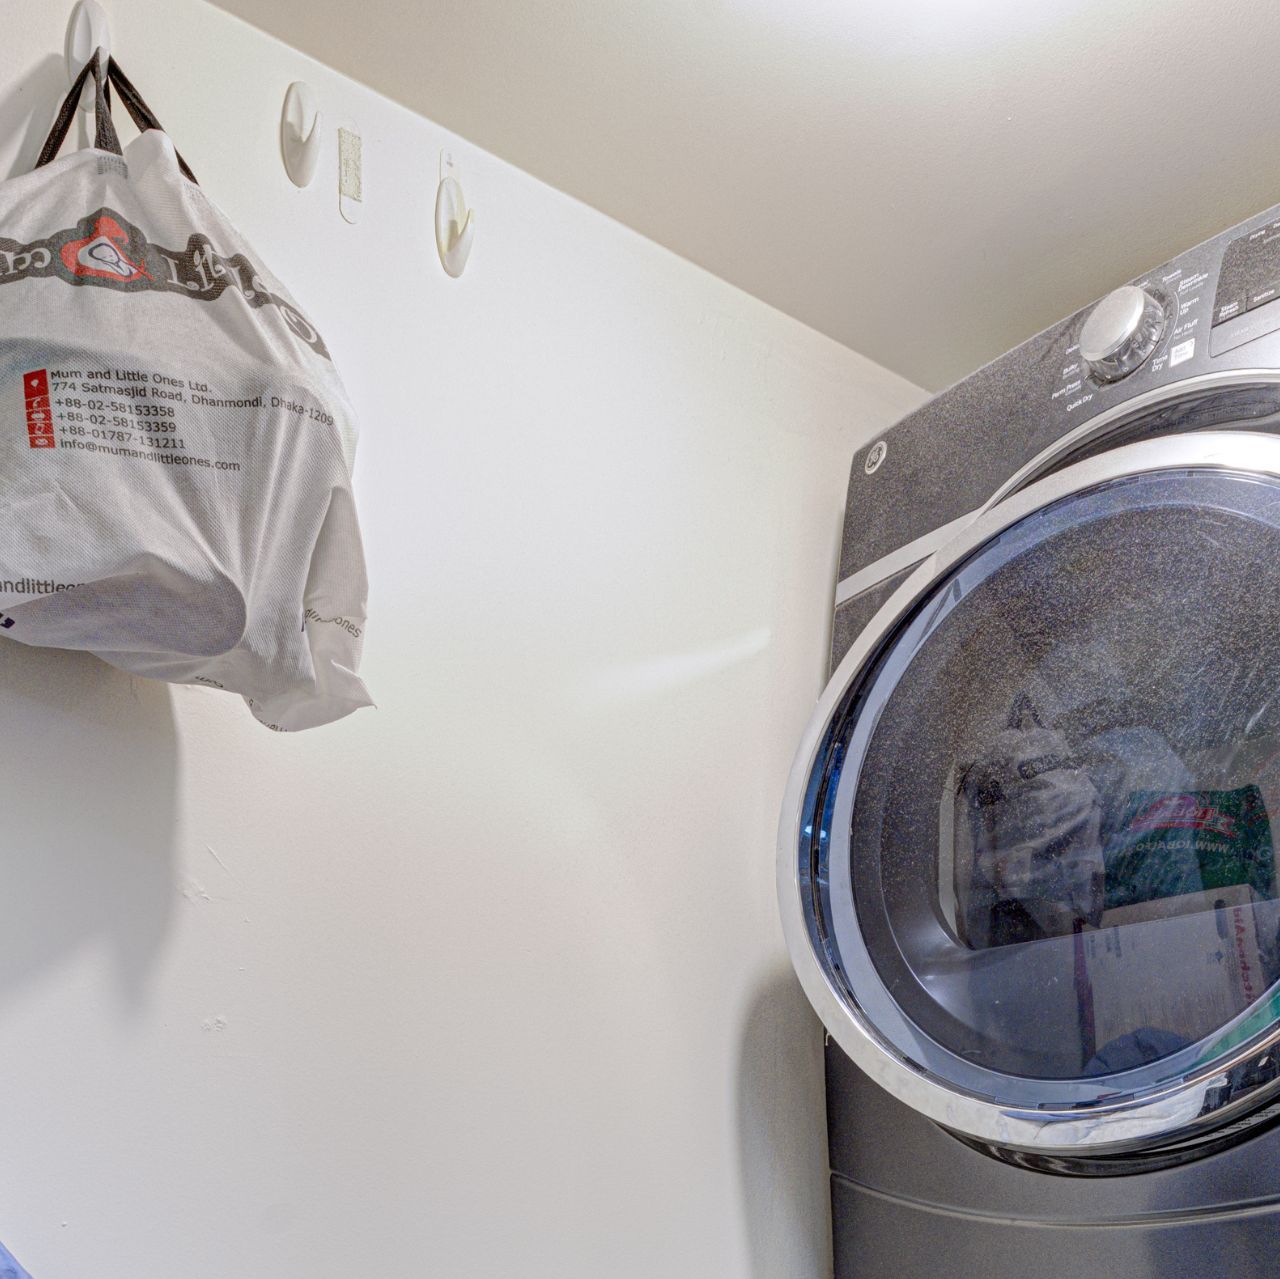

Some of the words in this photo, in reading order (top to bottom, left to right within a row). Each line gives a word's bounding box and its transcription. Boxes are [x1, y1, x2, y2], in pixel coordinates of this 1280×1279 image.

[51, 371, 82, 380] Mum
[87, 370, 111, 380] and
[116, 370, 148, 382] Little
[152, 373, 185, 388] Ones
[189, 380, 212, 393] Ltd.
[52, 382, 76, 392] 774
[82, 382, 147, 398] Satmasjid
[152, 387, 186, 404] Road,
[192, 394, 267, 410] Dhanmondi,
[271, 396, 334, 426] Dhaka-1209
[55, 397, 175, 417] +88-02-58153358
[57, 412, 176, 433] +88-02-58153359
[59, 425, 186, 449] +88-01787-131211
[60, 439, 241, 471] info@mumandlittleones.com
